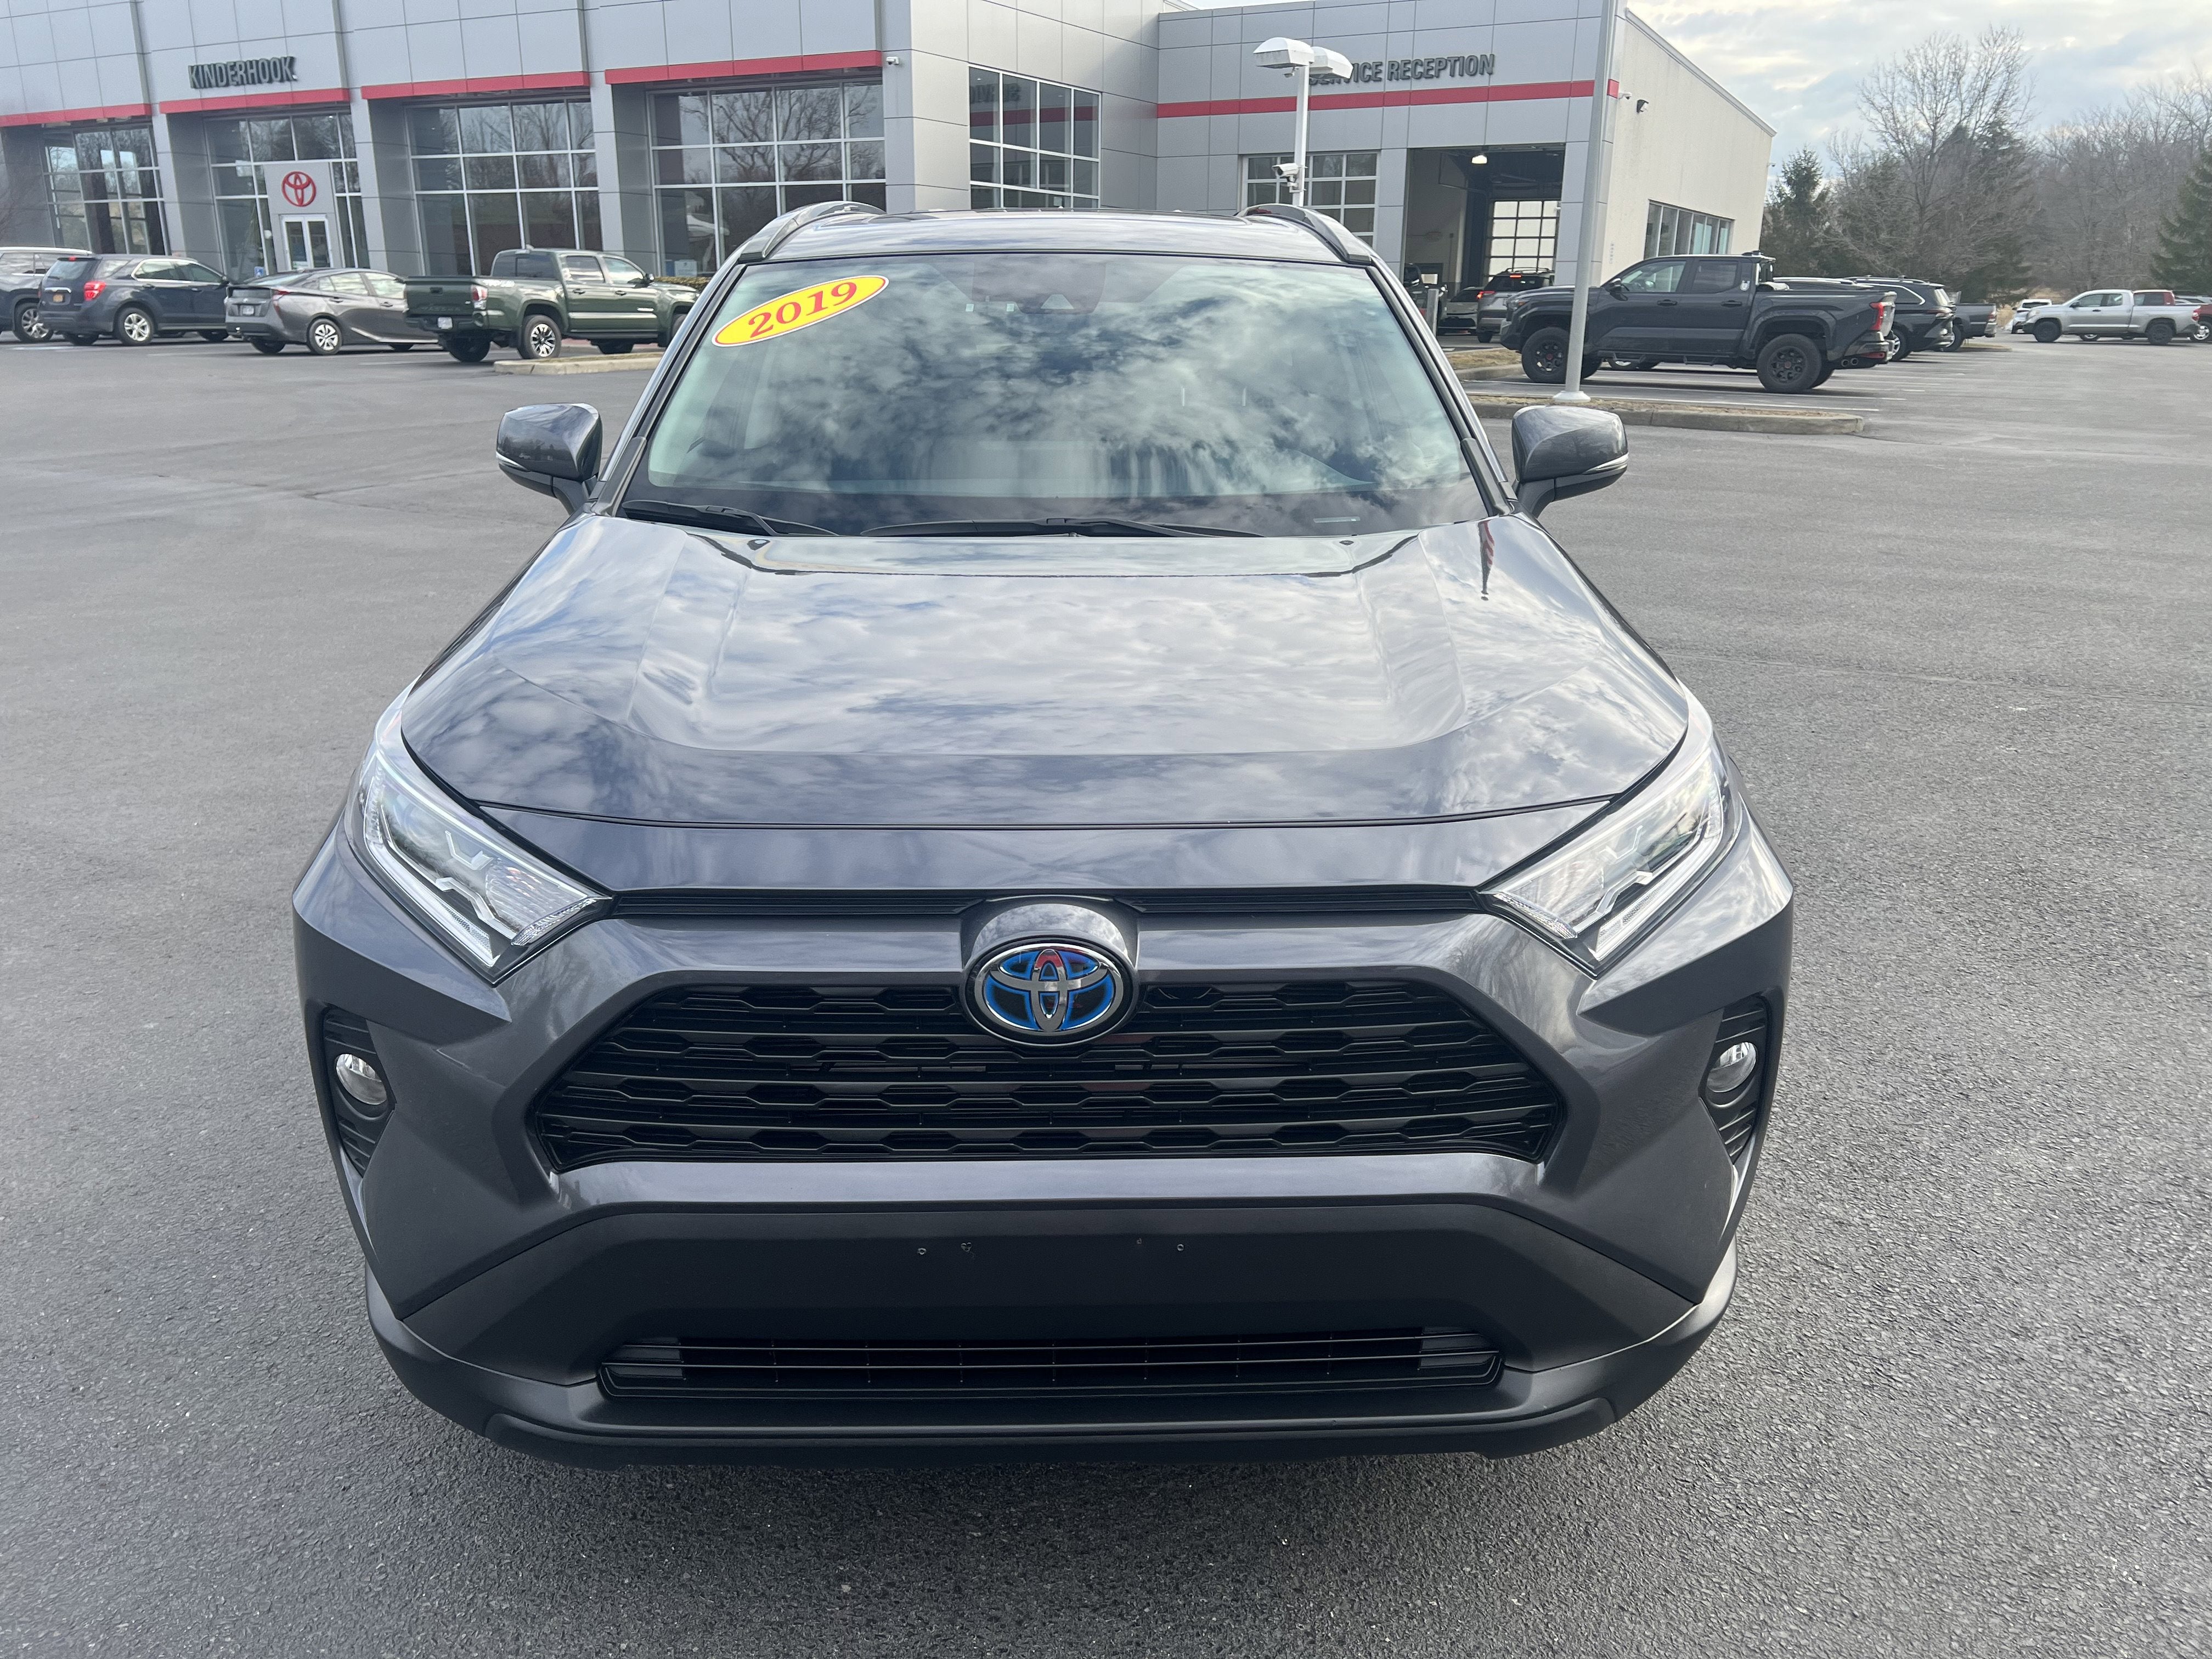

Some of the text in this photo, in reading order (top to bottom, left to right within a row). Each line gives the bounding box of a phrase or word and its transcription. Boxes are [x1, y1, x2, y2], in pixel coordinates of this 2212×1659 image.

[188, 56, 297, 89] KINDERHOOK
[1387, 54, 1495, 81] RECEPTION
[748, 282, 857, 338] 2019
